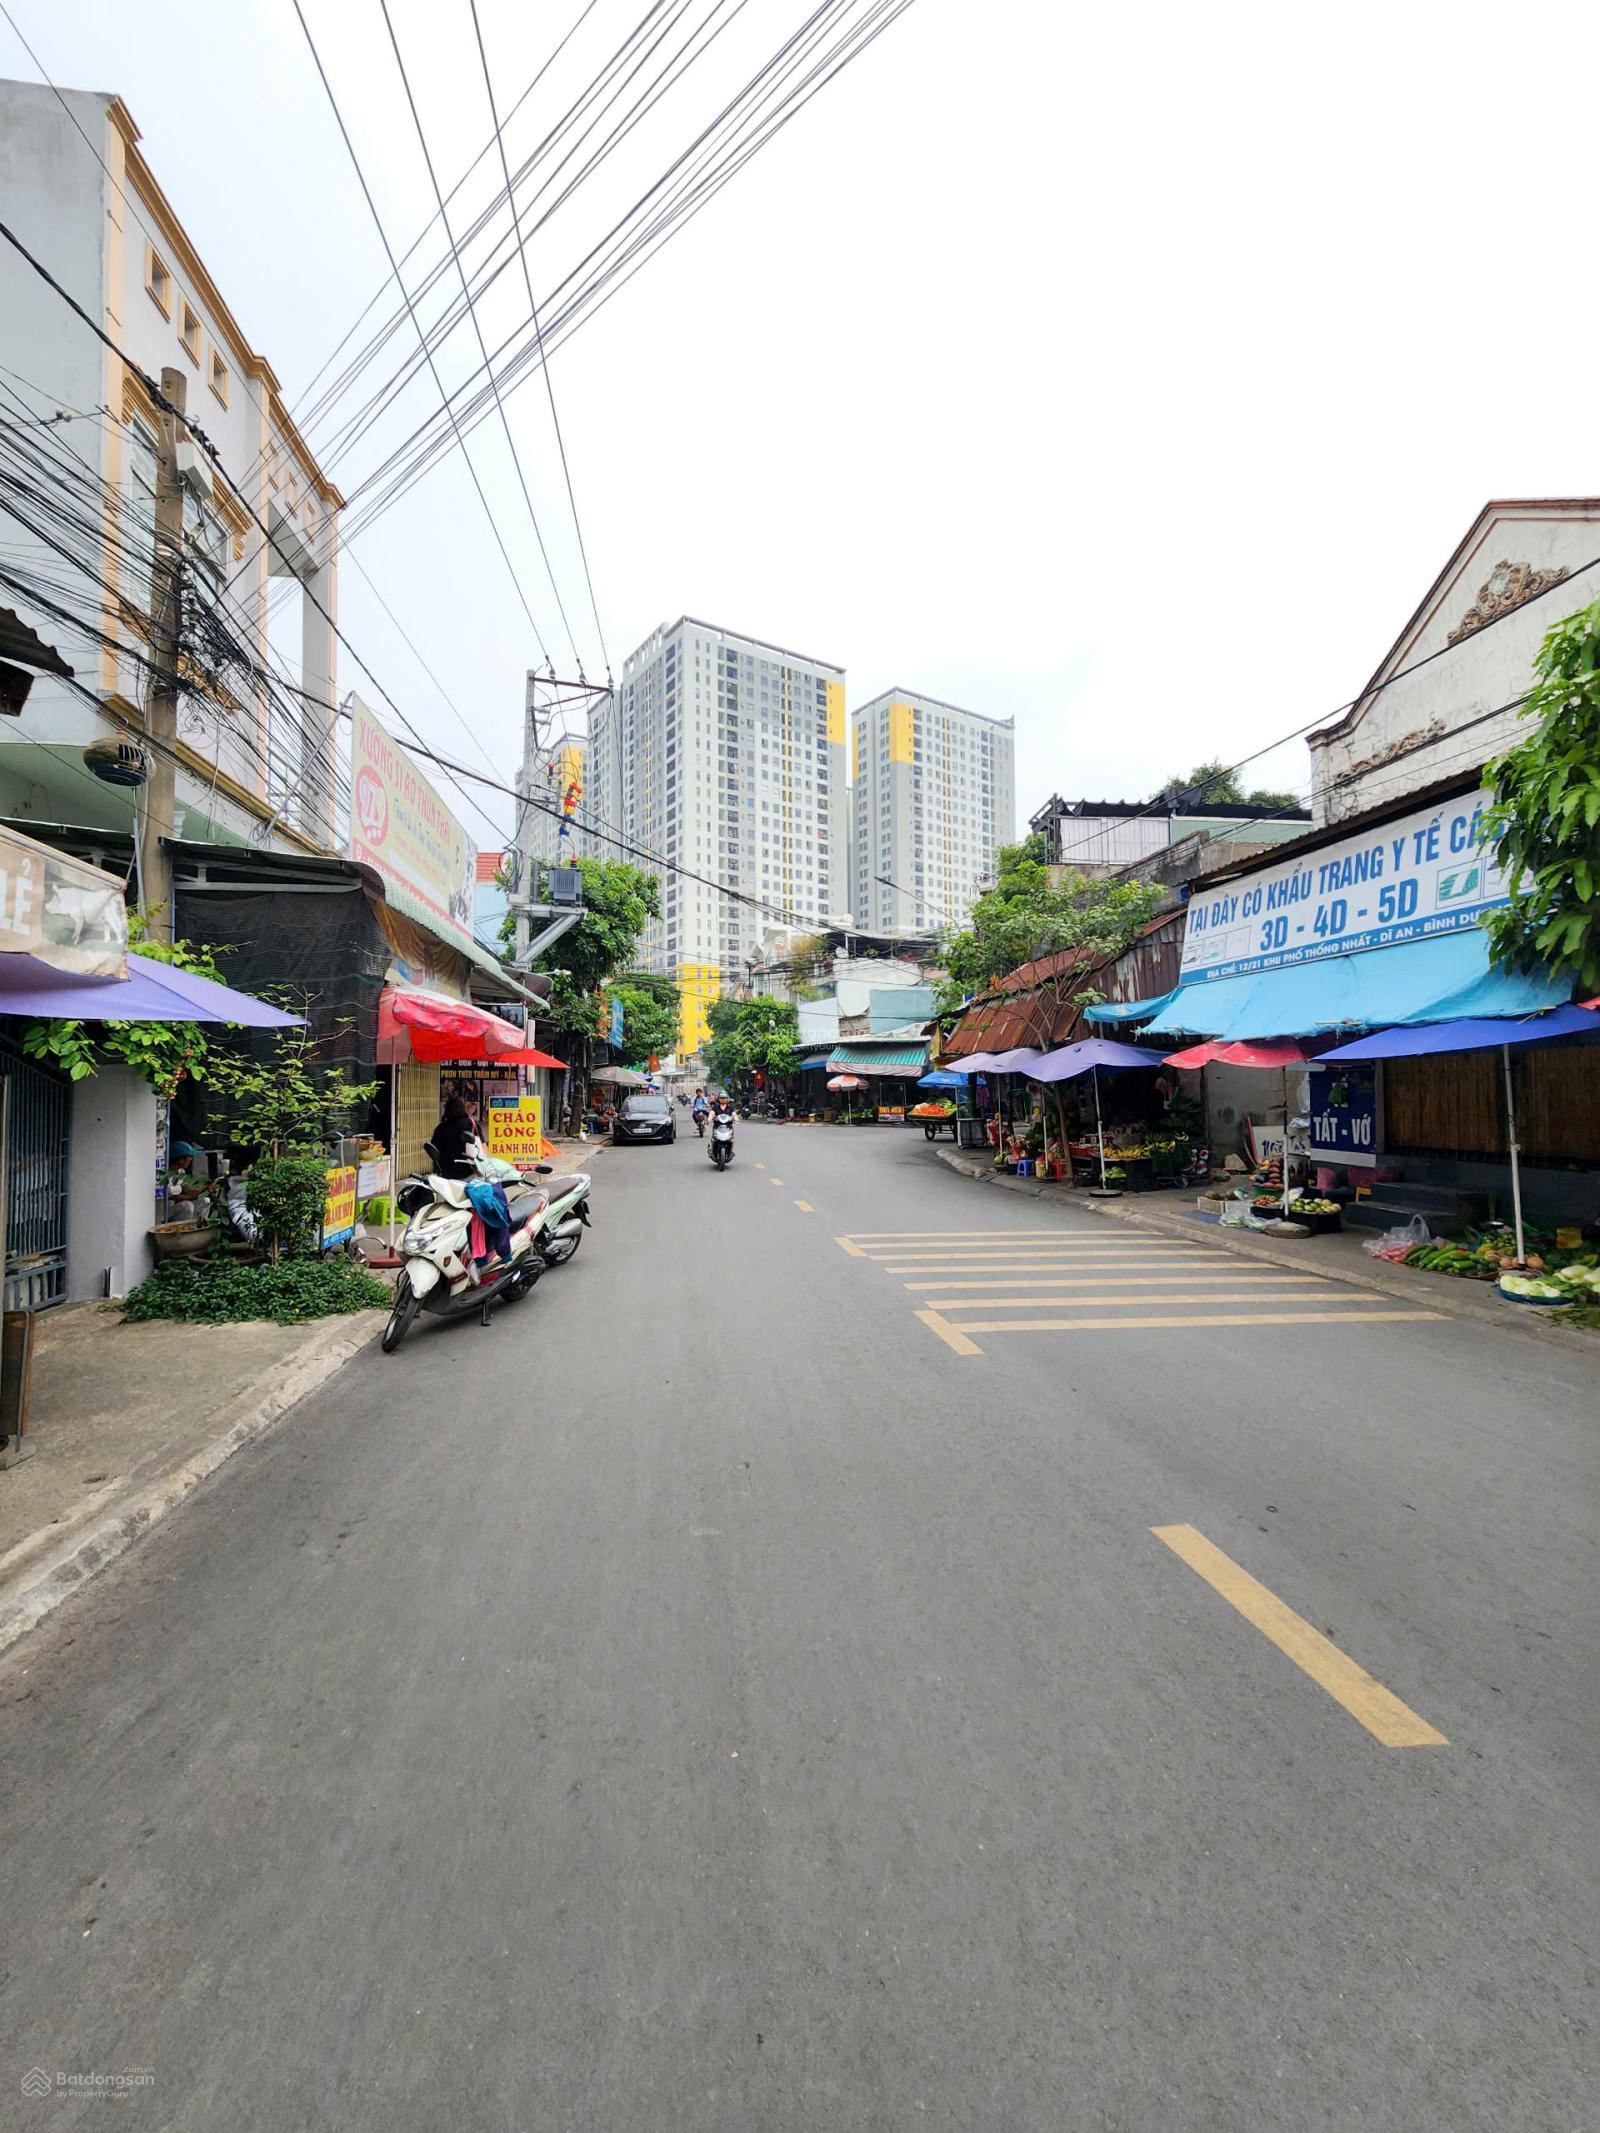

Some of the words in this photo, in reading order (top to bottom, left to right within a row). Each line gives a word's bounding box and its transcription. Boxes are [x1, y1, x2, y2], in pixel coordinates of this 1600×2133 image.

[1189, 904, 1209, 938] TẠI
[1211, 895, 1238, 928] ĐÂY
[1242, 882, 1262, 918] CÓ
[1266, 862, 1313, 911] KHẨU
[1319, 845, 1384, 895] TRANG
[1392, 837, 1406, 872] Y
[1413, 811, 1444, 865] TẾ
[1260, 915, 1288, 951] 3D
[1313, 898, 1348, 938] 4D
[1378, 877, 1419, 923] 5D
[1264, 957, 1281, 969] KHU
[1283, 949, 1303, 965] PHỐ
[1305, 942, 1340, 958] THỐNG
[1342, 931, 1371, 951] NHẤT
[1395, 926, 1413, 940] AN
[1424, 915, 1456, 932] BÌNH
[493, 1109, 536, 1123] CHÁO
[1313, 1108, 1338, 1142] TẤT
[1351, 1113, 1371, 1145] VỚ
[492, 1140, 519, 1153] BÁNH
